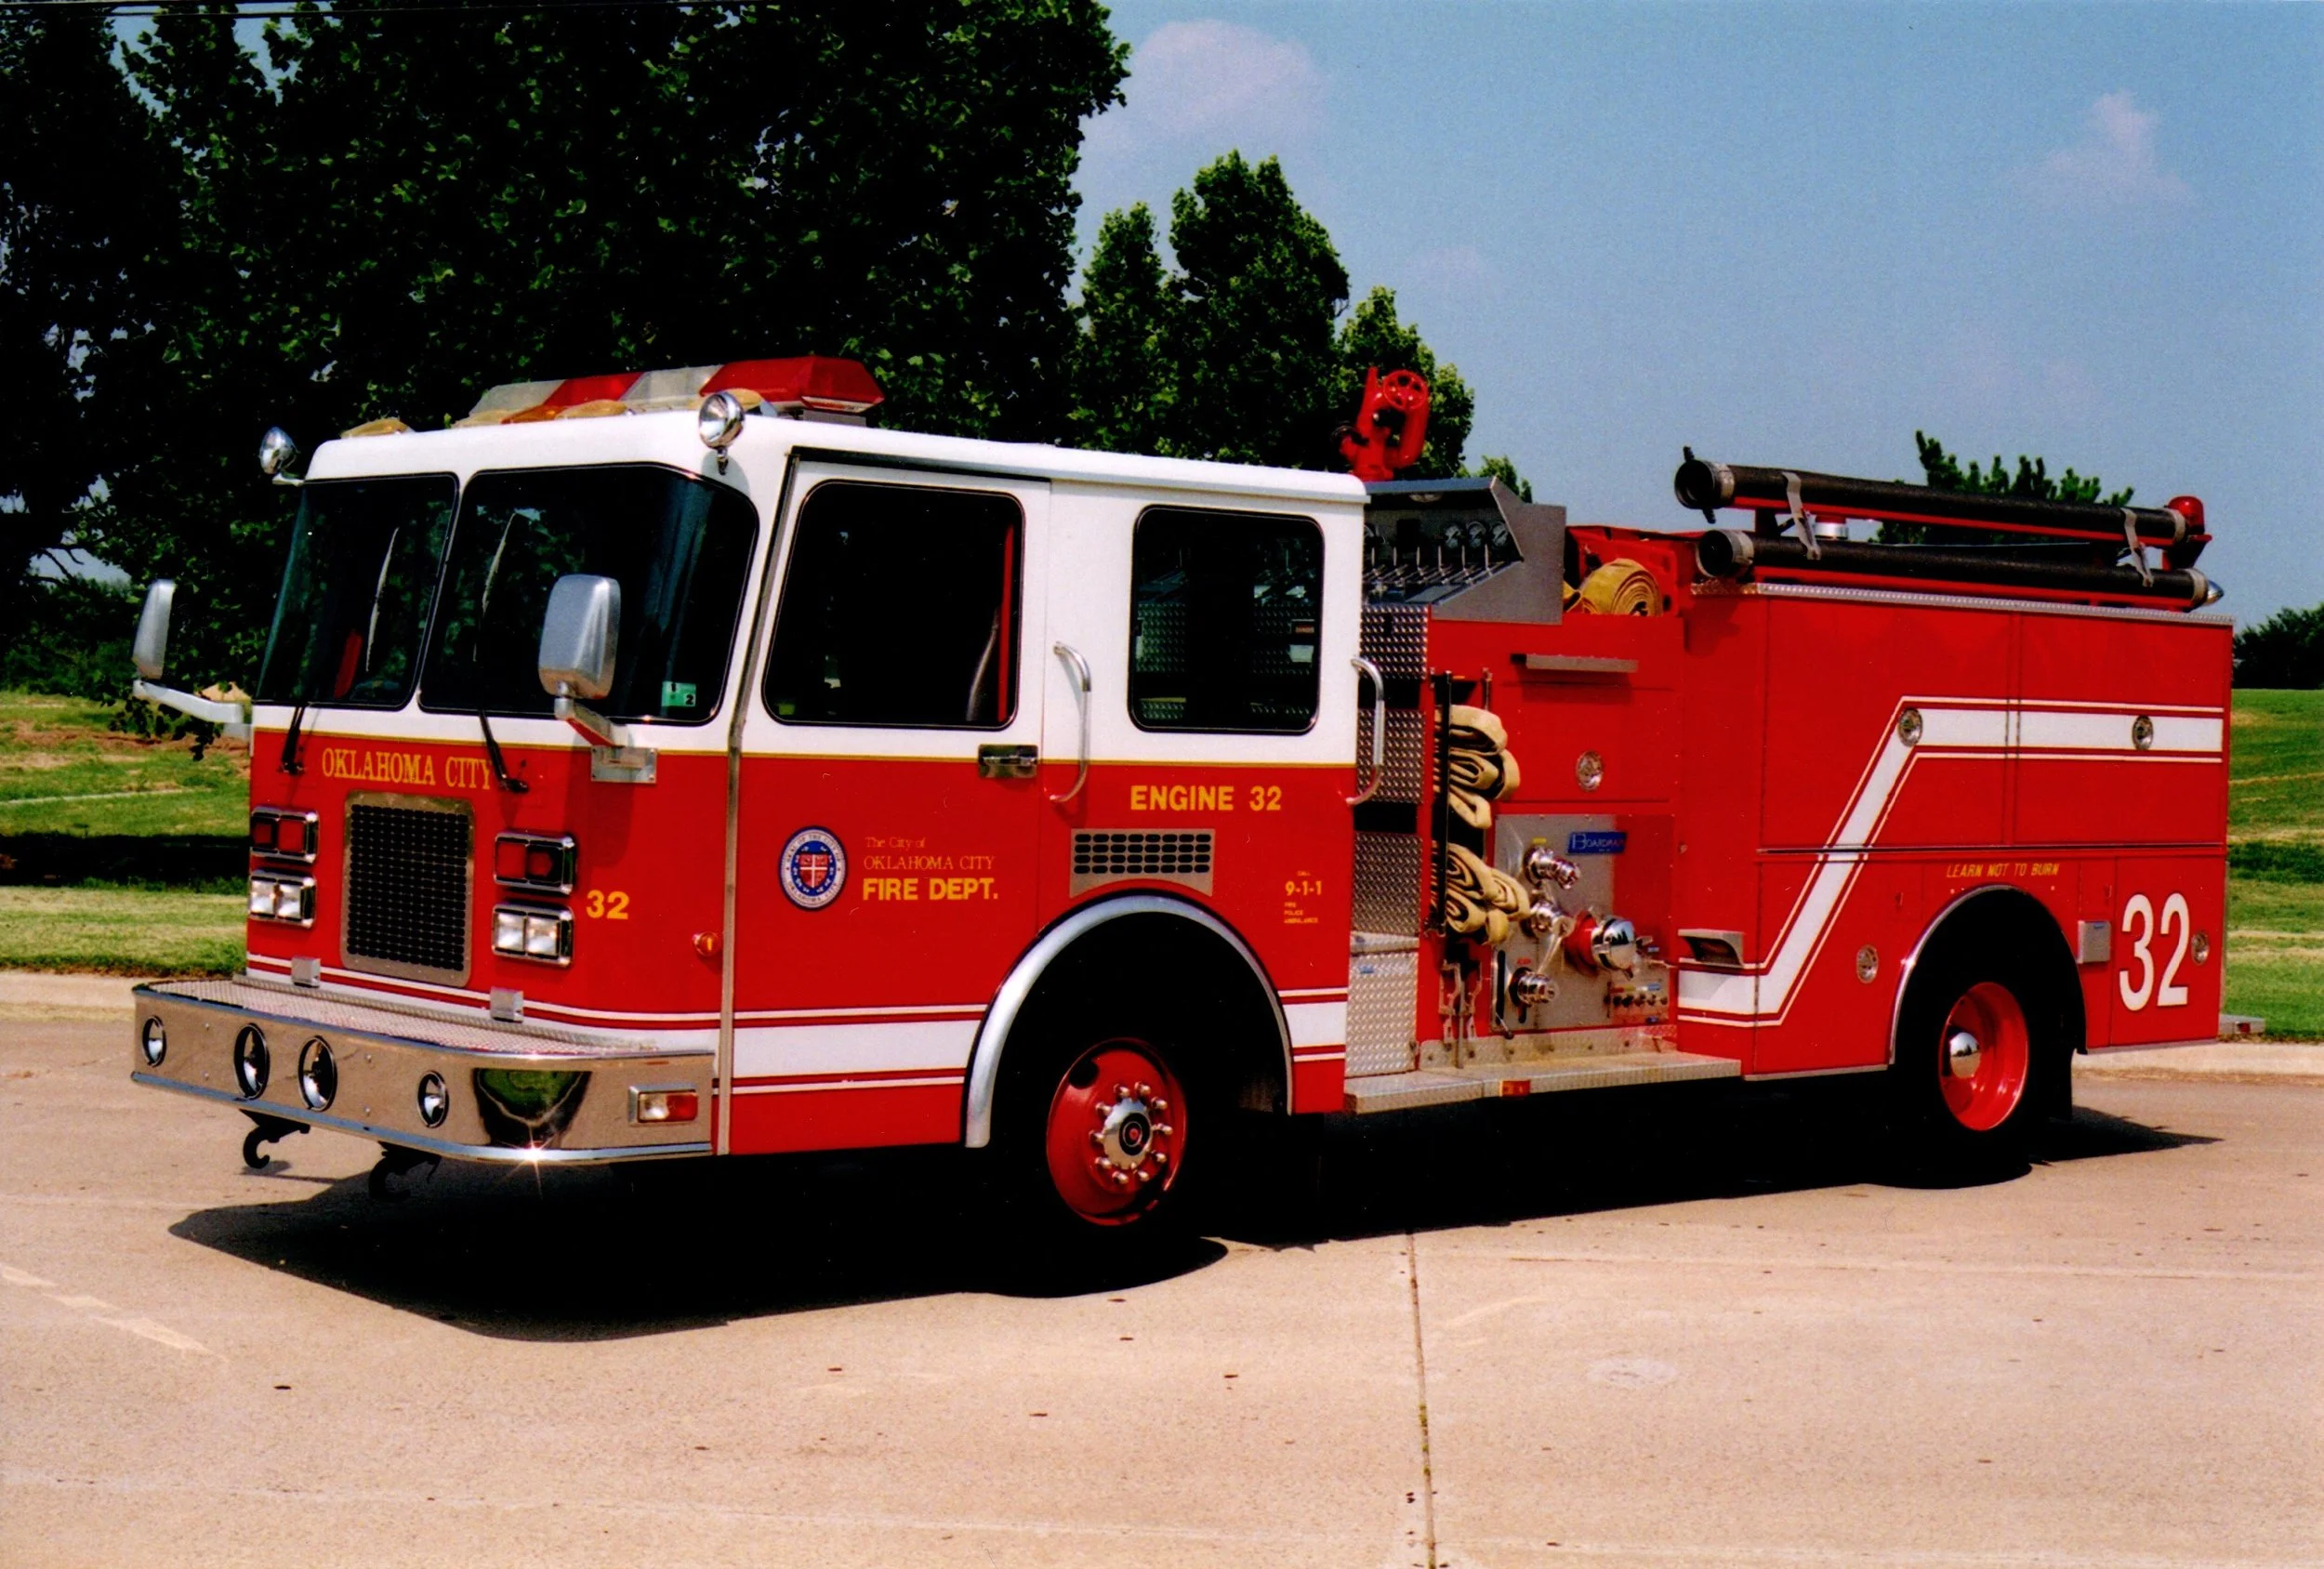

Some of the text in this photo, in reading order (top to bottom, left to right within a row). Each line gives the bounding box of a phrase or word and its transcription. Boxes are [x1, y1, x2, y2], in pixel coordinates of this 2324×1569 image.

[686, 694, 693, 705] 2
[322, 747, 492, 789] OKLAHOMA CITY
[1130, 784, 1282, 811] ENGINE 32
[865, 837, 926, 851] The City of
[864, 855, 995, 870] OKLAHOMA CITY
[1946, 863, 2060, 878] LEARN NOT TO BURN
[863, 877, 998, 901] FIRE DEPT.
[1285, 880, 1322, 896] 9-1-1
[586, 890, 629, 919] 32
[2119, 892, 2190, 1011] 32
